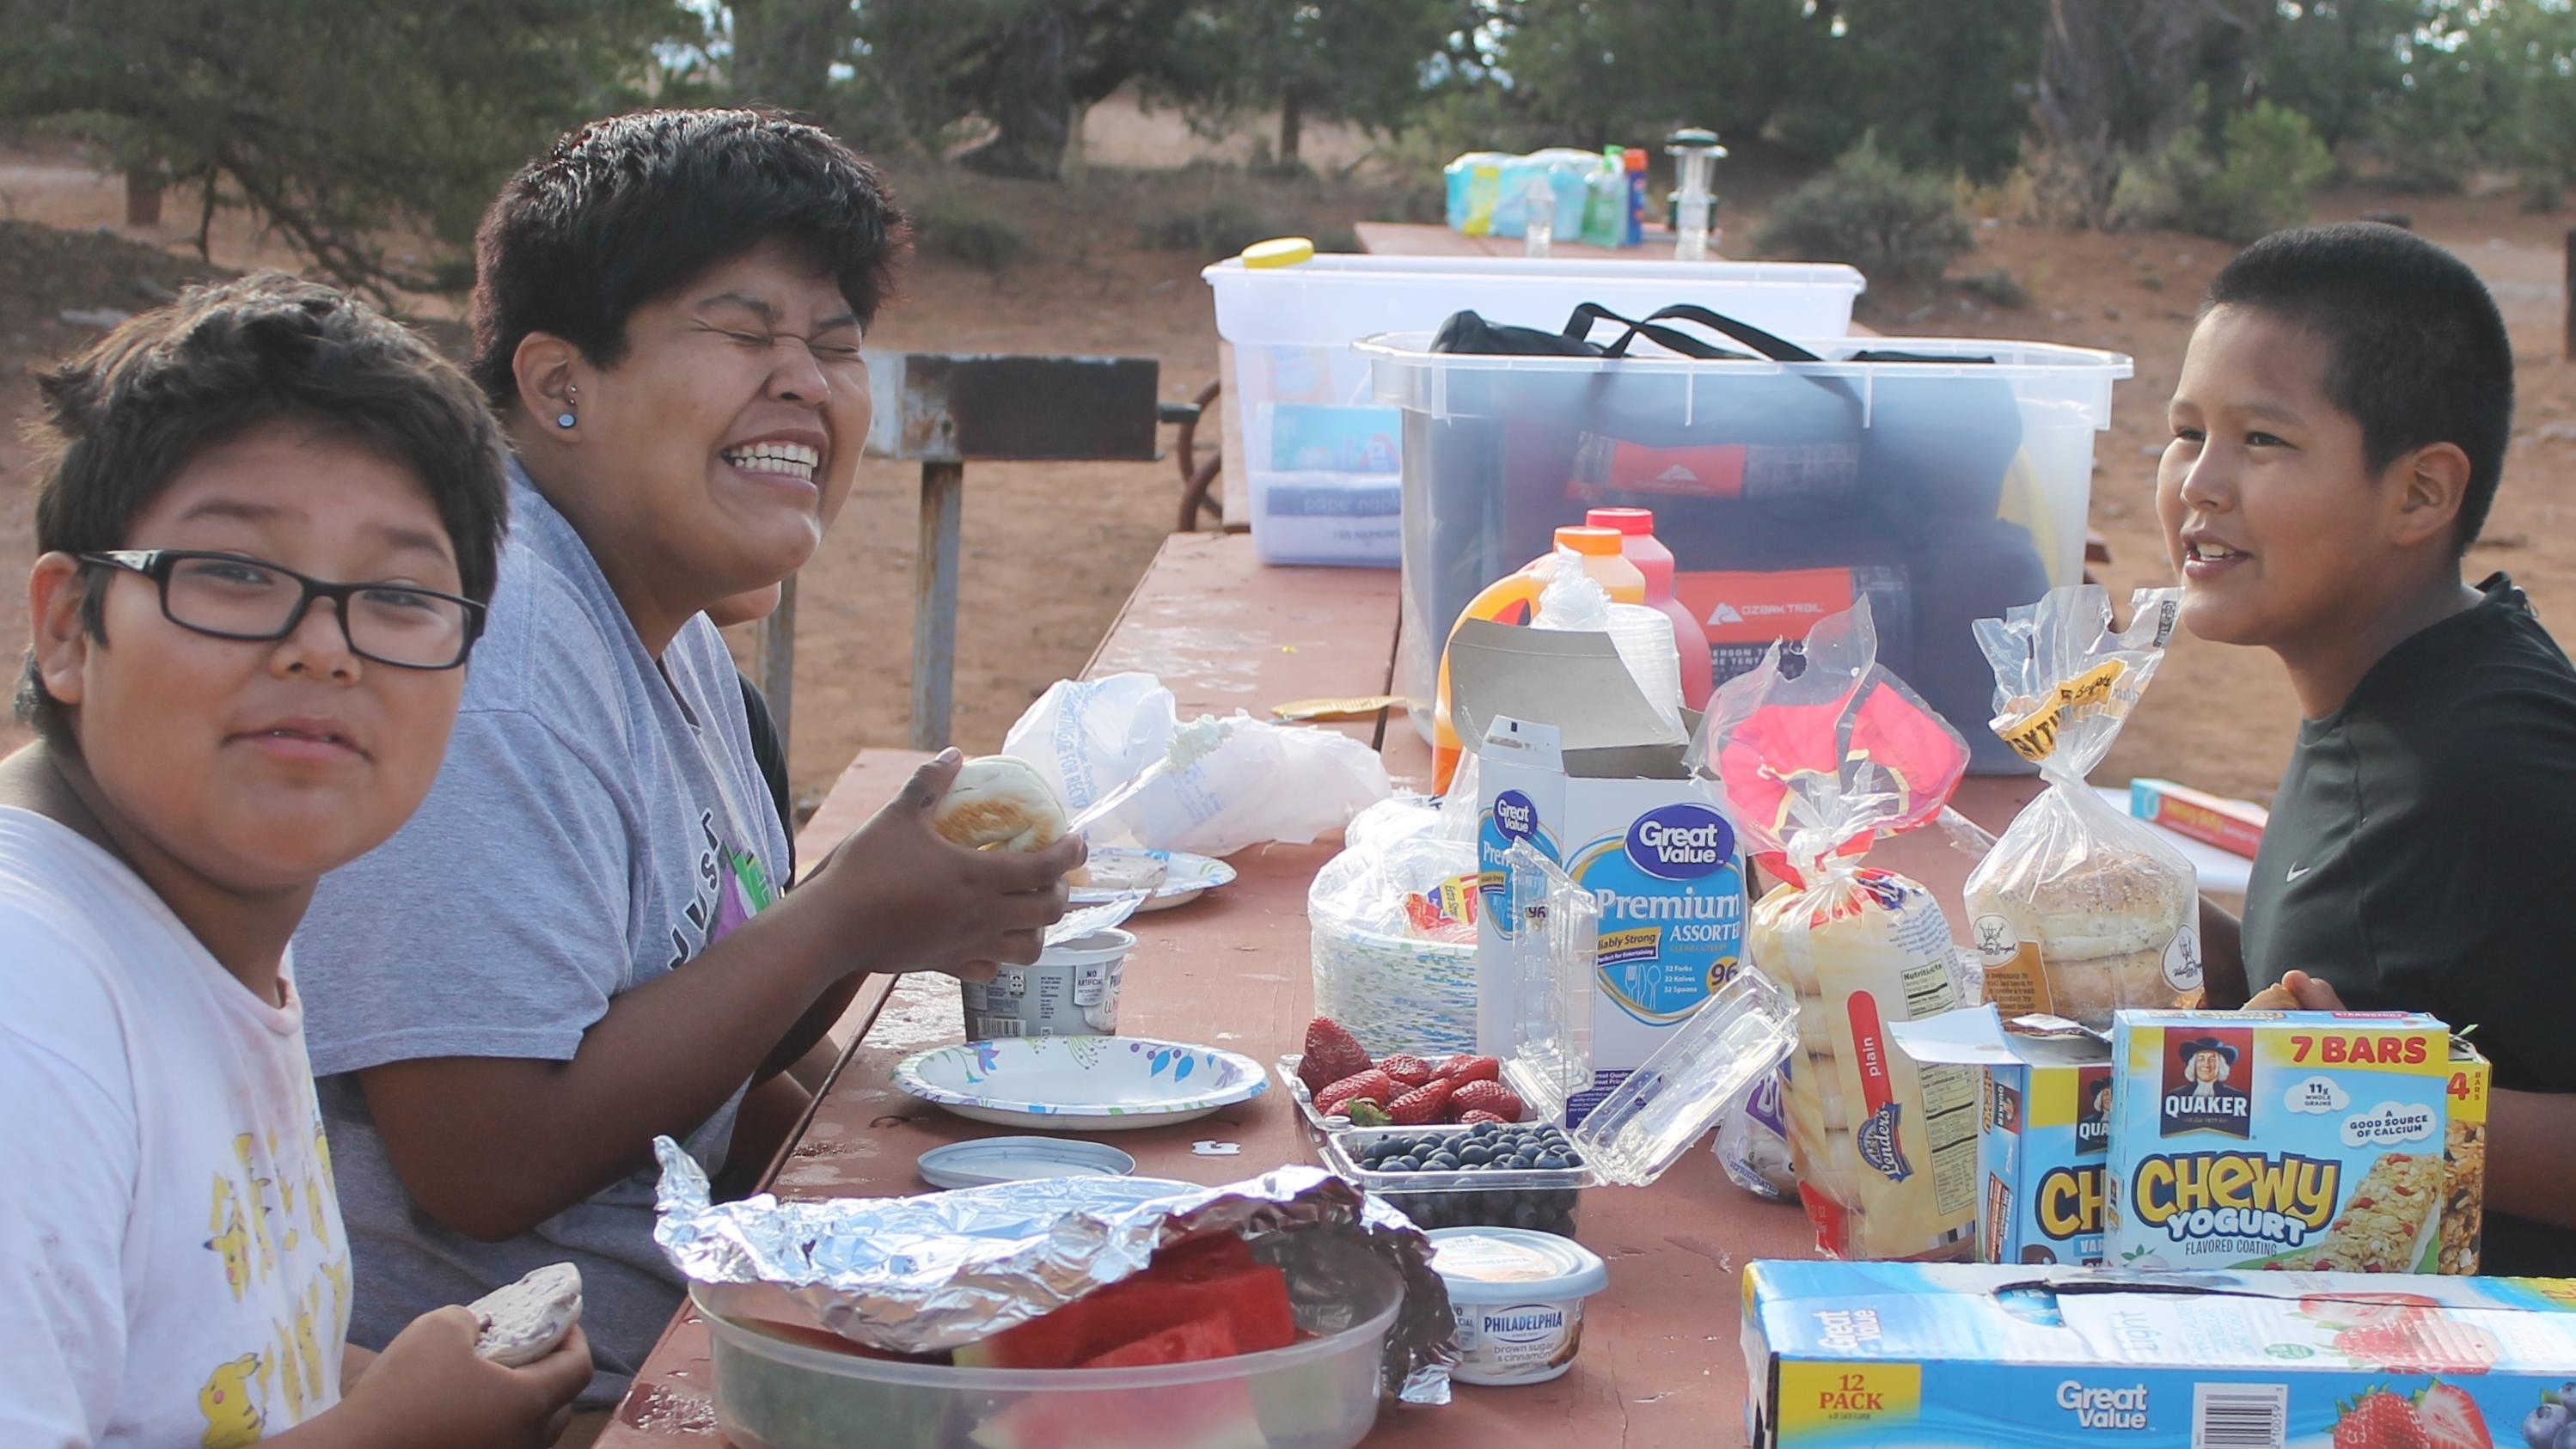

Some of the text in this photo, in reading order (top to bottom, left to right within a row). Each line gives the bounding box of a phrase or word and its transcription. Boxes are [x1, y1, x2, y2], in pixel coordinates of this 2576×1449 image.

[1741, 602, 1824, 616] OZARK TRAIL
[1711, 647, 1753, 657] ERSON
[1497, 798, 1530, 822] Great
[1504, 817, 1530, 833] Value
[1638, 819, 1719, 849] Great
[1656, 842, 1717, 865] Value
[1594, 886, 1741, 920] Premium
[1598, 932, 1656, 951] liably Strong
[1669, 921, 1741, 943] ASSORTE
[1086, 969, 1098, 979] NO
[1710, 963, 1738, 986] 96
[1862, 1036, 1881, 1078] plain
[2290, 1035, 2427, 1064] 7 BARS
[1609, 1071, 1630, 1079] Quali
[2308, 1083, 2329, 1096] 11g
[1997, 1084, 2005, 1128] QUAKER
[2165, 1095, 2248, 1118] QUAKER
[2385, 1110, 2393, 1118] A
[2349, 1115, 2429, 1130] GOOD SOURCE
[2356, 1124, 2423, 1138] OF CALCIUM
[2165, 1206, 2307, 1244] YOGURT
[2185, 1238, 2277, 1257] FLAVORED COATING
[1484, 1311, 1563, 1333] PHILADELPHIA
[1811, 1310, 1858, 1349] Great
[1851, 1309, 1882, 1342] Value
[1493, 1342, 1555, 1355] brown sugar
[1504, 1351, 1551, 1362] cinnamon
[1838, 1373, 1865, 1391] 12
[1819, 1391, 1884, 1411] PACK
[2055, 1379, 2148, 1411] Great
[2077, 1408, 2147, 1430] Value
